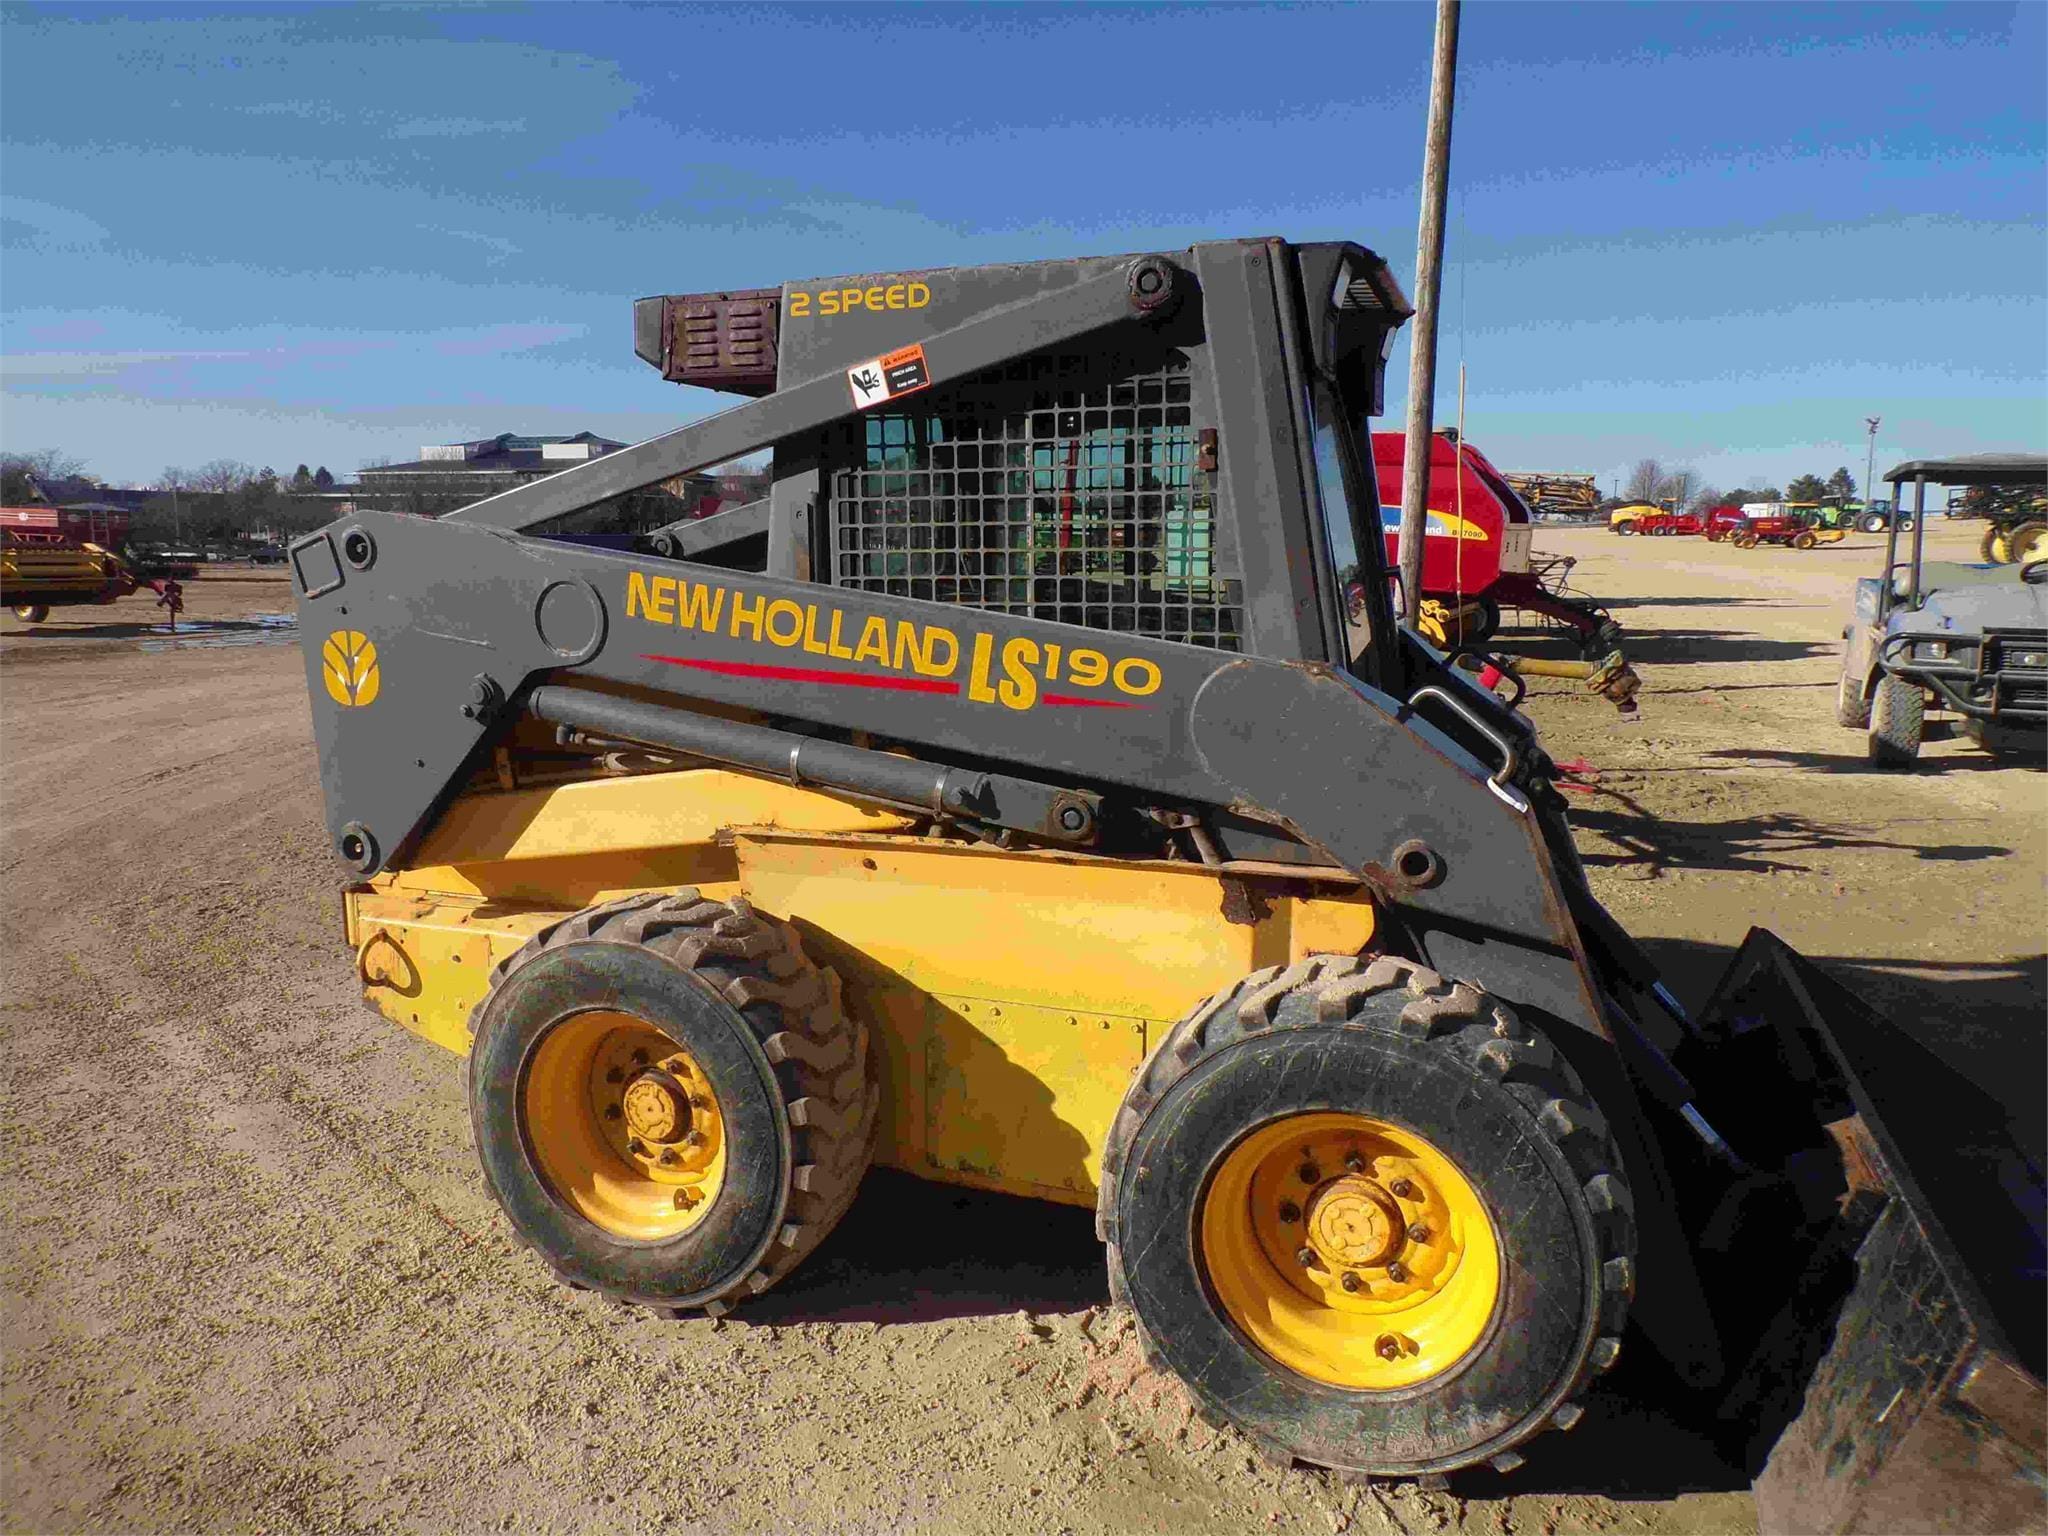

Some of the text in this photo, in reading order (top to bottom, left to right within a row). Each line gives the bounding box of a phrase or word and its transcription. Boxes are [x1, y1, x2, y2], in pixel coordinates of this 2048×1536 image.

[791, 283, 931, 317] 2 SPEED
[626, 570, 726, 634] NEW
[728, 593, 961, 679] HOLLAND
